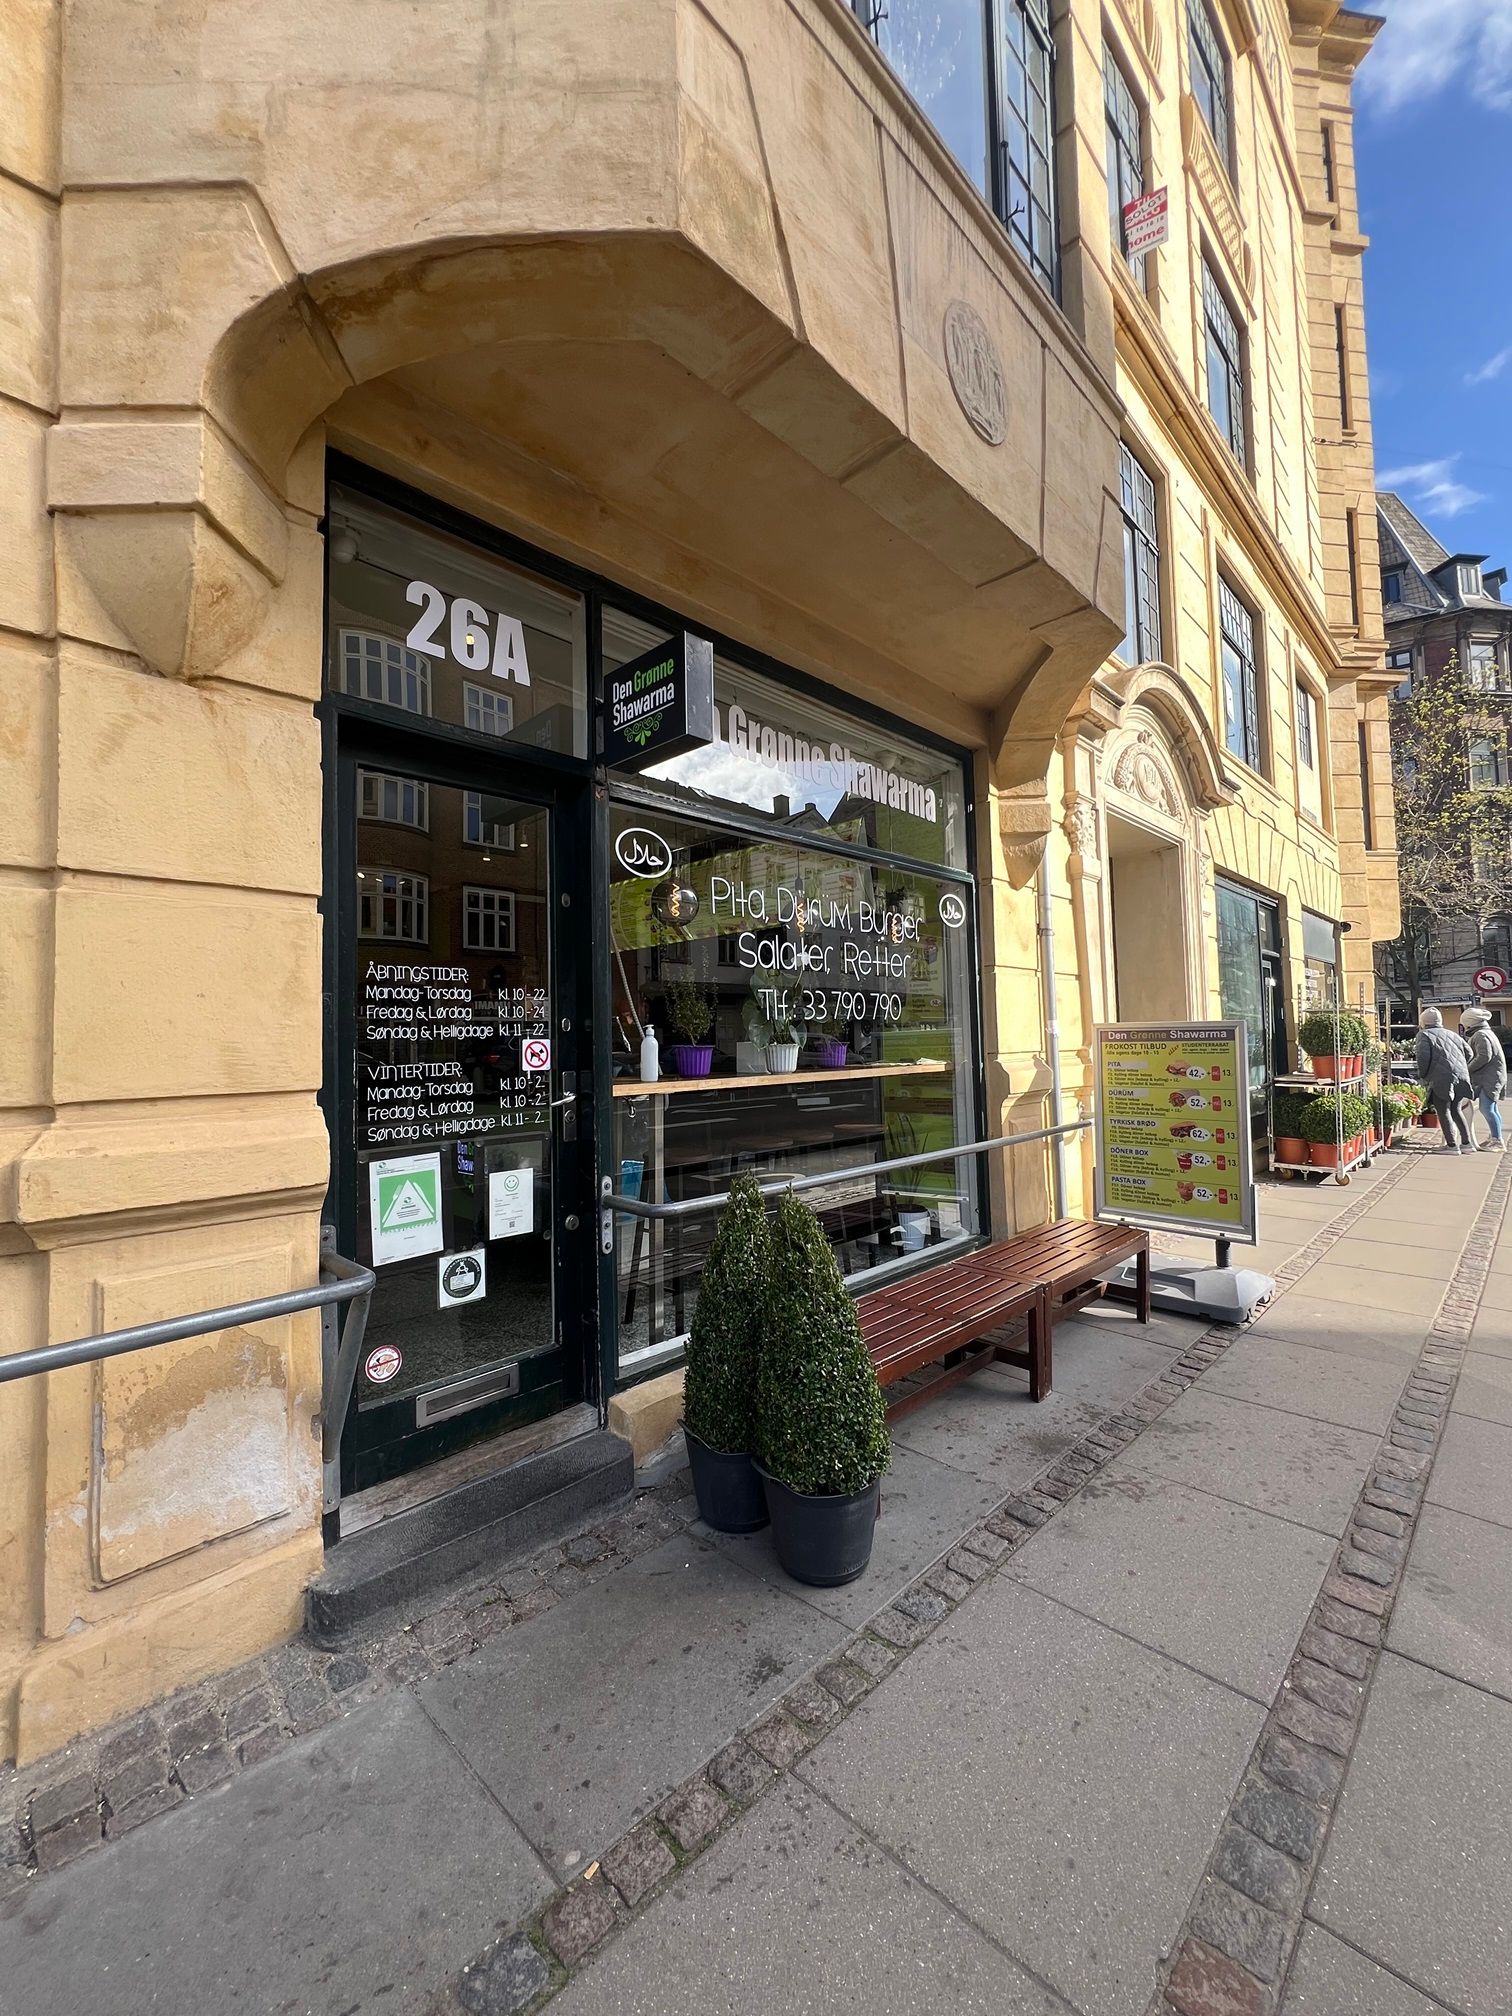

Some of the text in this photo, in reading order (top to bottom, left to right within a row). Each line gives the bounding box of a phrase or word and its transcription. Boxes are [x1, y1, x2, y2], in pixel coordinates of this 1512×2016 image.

[405, 580, 531, 688] 26A
[612, 658, 674, 704] Den Grønne
[613, 682, 675, 726] Shawarma
[728, 705, 825, 785] Grønne
[830, 742, 937, 823] Shawarma
[711, 876, 770, 924] Pita,
[860, 901, 923, 944] Burger,
[738, 931, 912, 982] Salater, Retter
[366, 985, 472, 1003] Mandag-Torsdag
[512, 988, 524, 1001] 10
[533, 988, 545, 1001] 22
[803, 990, 827, 1021] 33
[831, 991, 866, 1021] 790
[870, 992, 902, 1021] 790
[366, 1004, 414, 1021] Fredag
[415, 1006, 428, 1021] &
[428, 1006, 472, 1021] Lørdag
[512, 1006, 524, 1018] 10
[533, 1006, 545, 1018] 24
[366, 1025, 418, 1041] Søndag
[420, 1028, 433, 1041] &
[433, 1024, 494, 1041] Helligdage
[513, 1024, 522, 1036] 11
[532, 1023, 545, 1036] 22
[1108, 1030, 1227, 1040] Den Grønne Shawarma
[367, 1062, 463, 1082] VINTERTIDER:
[367, 1081, 474, 1102] Mandag-Torsdag
[514, 1077, 526, 1090] 10
[367, 1104, 415, 1122] Fredag
[417, 1103, 430, 1119] &
[430, 1100, 474, 1117] Lørdag
[514, 1095, 526, 1108] 10
[1109, 1118, 1136, 1126] TYRKISK
[367, 1124, 419, 1142] Søndag
[422, 1123, 435, 1139] &
[435, 1117, 496, 1136] Helligdage
[514, 1113, 524, 1126] 11
[1111, 1176, 1131, 1184] PASTA
